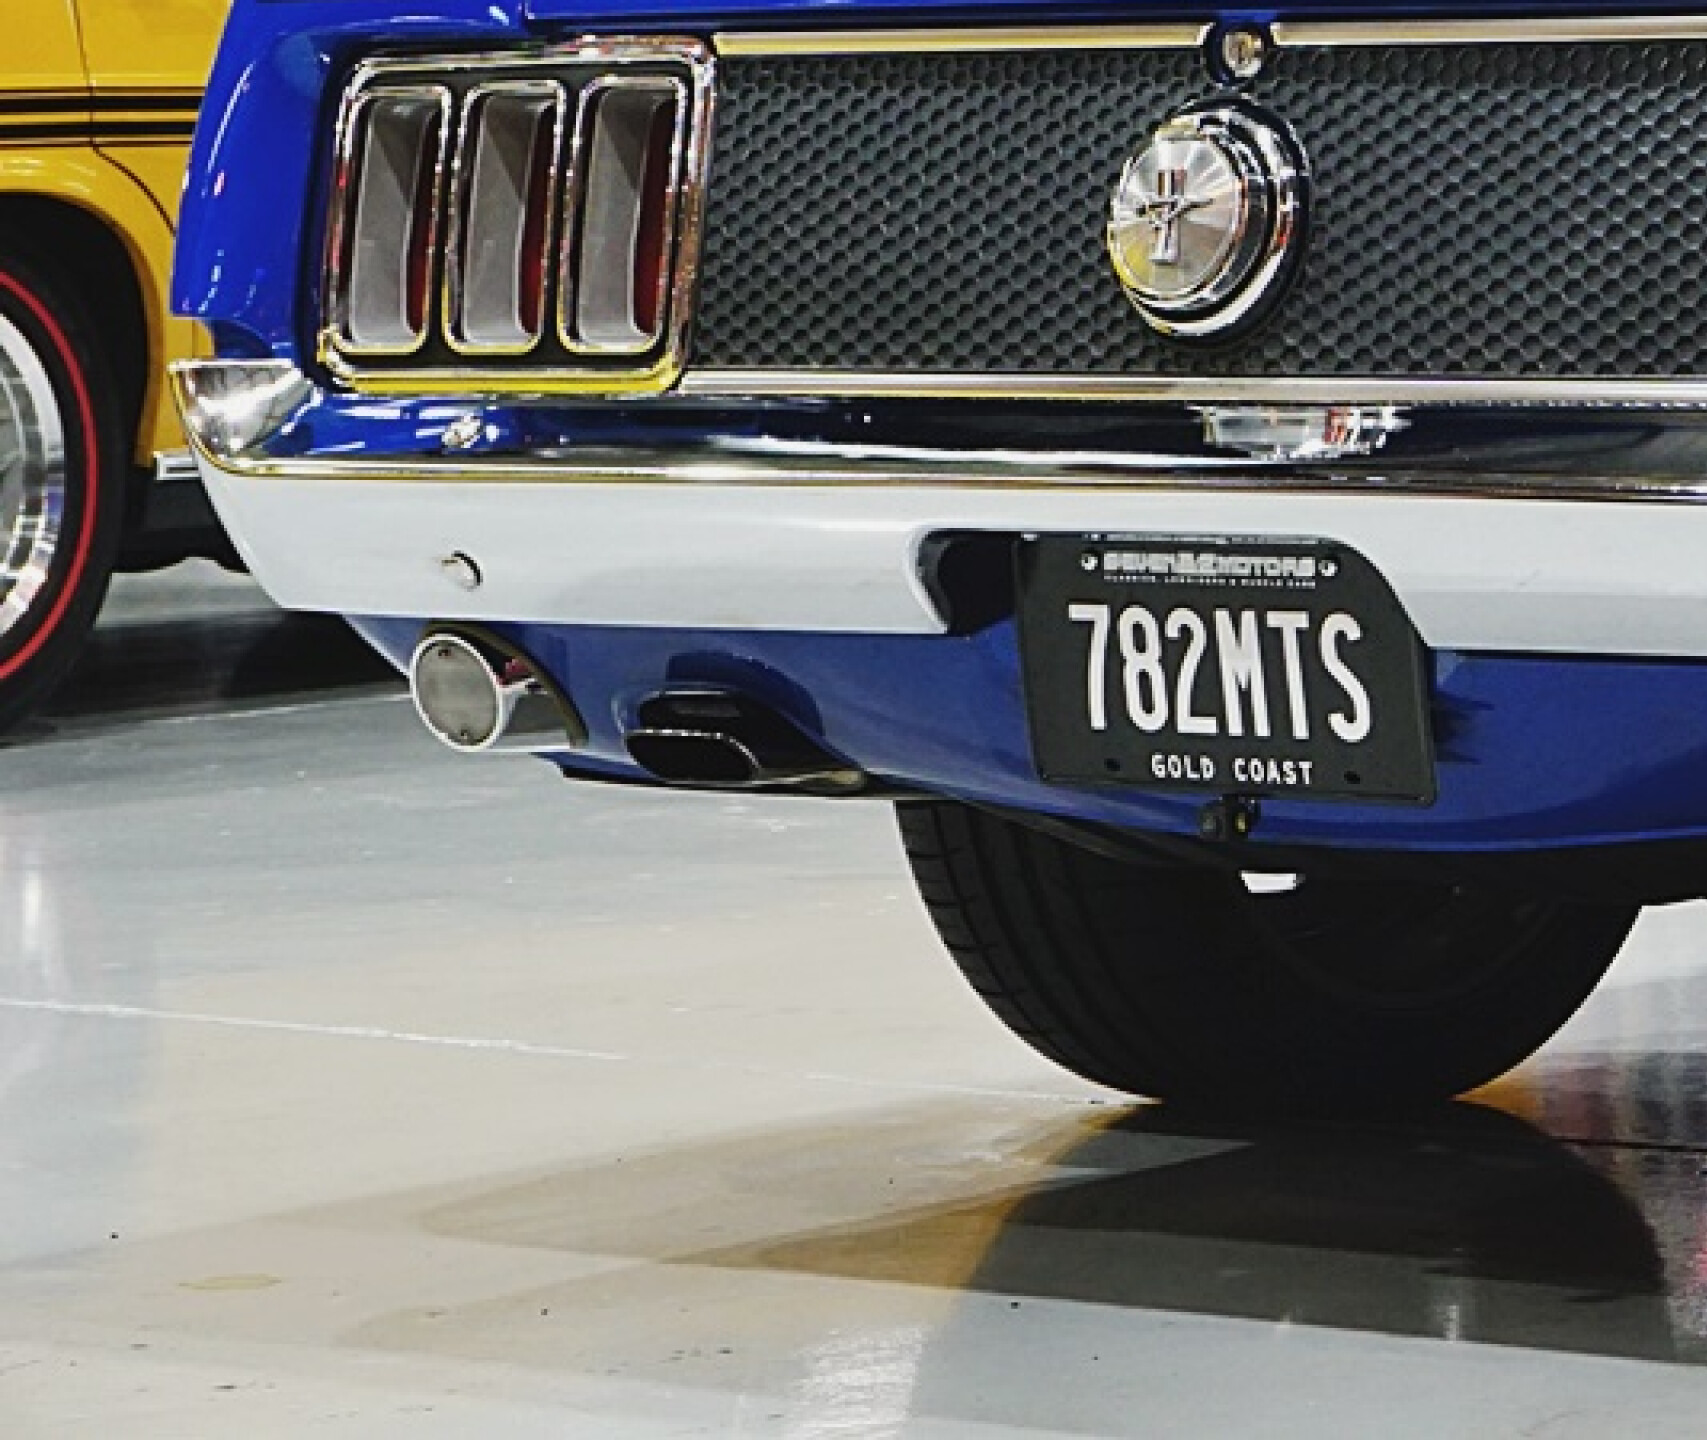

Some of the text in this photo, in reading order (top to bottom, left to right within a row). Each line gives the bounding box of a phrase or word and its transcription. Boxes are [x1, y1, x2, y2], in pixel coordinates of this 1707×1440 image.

[1068, 603, 1371, 743] 782MTS
[1151, 753, 1313, 785] GOLD COAST
